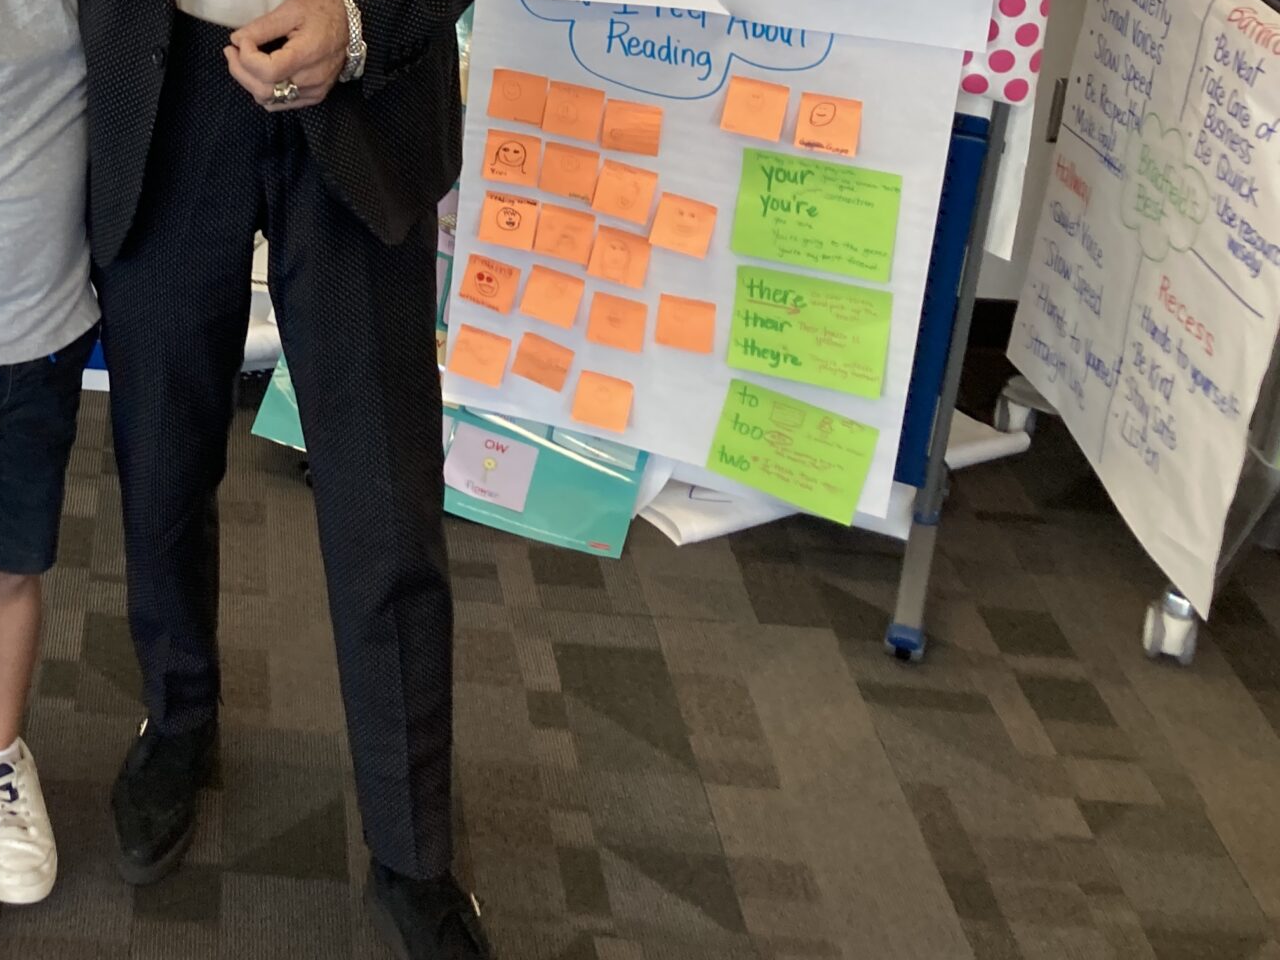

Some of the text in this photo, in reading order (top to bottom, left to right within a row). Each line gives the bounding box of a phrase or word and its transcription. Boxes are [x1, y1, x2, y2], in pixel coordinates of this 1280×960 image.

[606, 18, 713, 81] Reading
[1132, 17, 1165, 66] Voices
[1214, 32, 1266, 87] Be Neat
[1094, 33, 1156, 101] Slow Speed
[1201, 64, 1226, 107] Take
[1227, 88, 1251, 129] Care
[761, 165, 816, 193] your
[1194, 128, 1260, 209] Be Quick
[760, 194, 819, 219] you're
[744, 276, 807, 309] there
[1158, 274, 1216, 357] Recess
[737, 384, 760, 409] to
[730, 412, 764, 441] too
[717, 444, 752, 472] two
